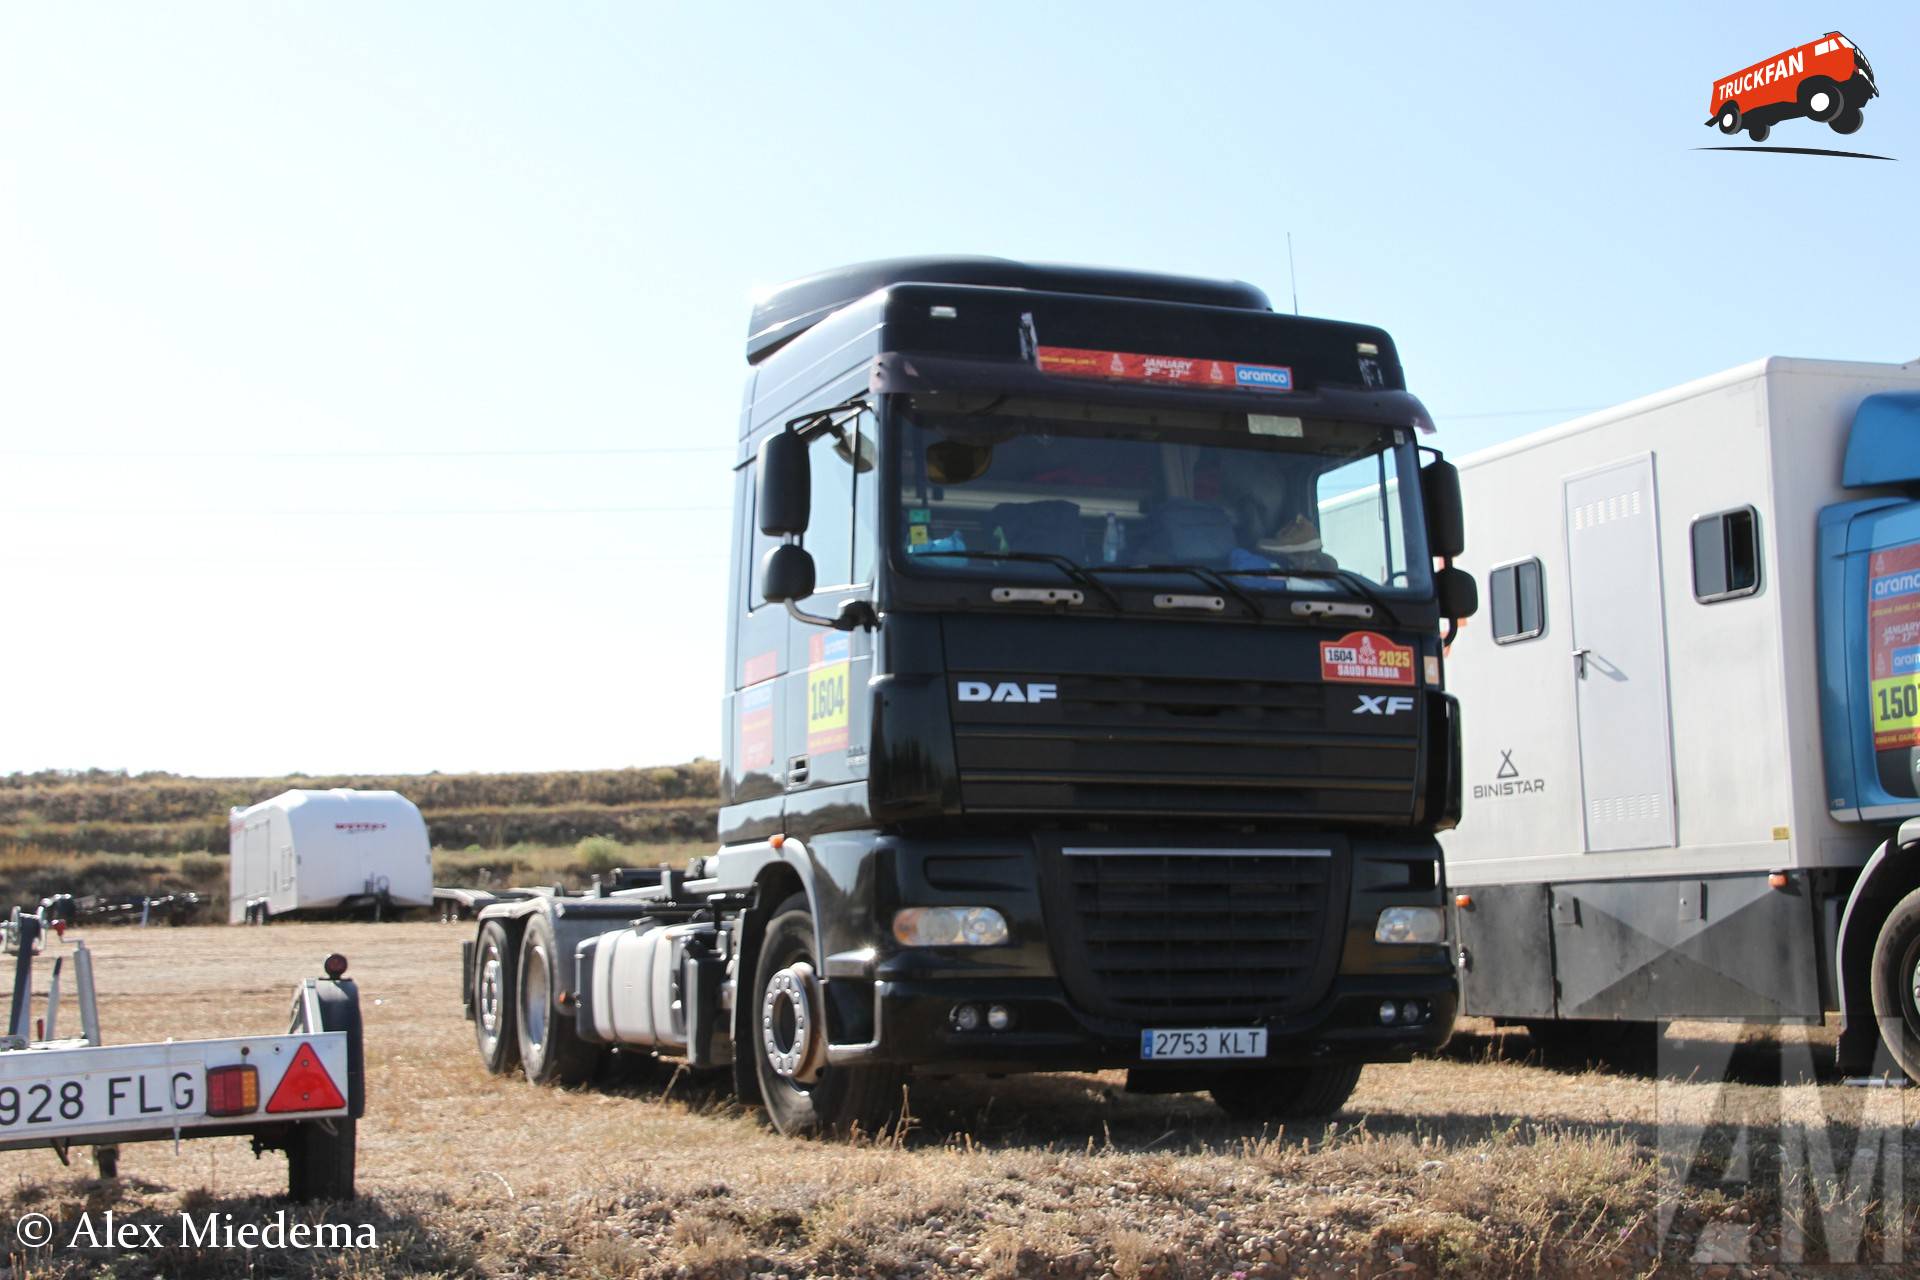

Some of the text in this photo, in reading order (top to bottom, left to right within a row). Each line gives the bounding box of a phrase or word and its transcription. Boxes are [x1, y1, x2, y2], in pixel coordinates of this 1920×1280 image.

[1142, 358, 1193, 370] JANUARY
[1238, 370, 1288, 384] aramco
[1327, 649, 1353, 662] 1604
[1379, 650, 1410, 668] 2025
[1337, 664, 1399, 679] SAUDI ARABIA
[811, 675, 845, 720] 1604
[957, 681, 1057, 703] DAF
[1352, 694, 1414, 715] XF
[1878, 684, 1920, 722] 150
[1473, 779, 1545, 799] BINISTAR
[1155, 1031, 1260, 1055] 2753 KLT
[108, 1071, 194, 1116] FLG
